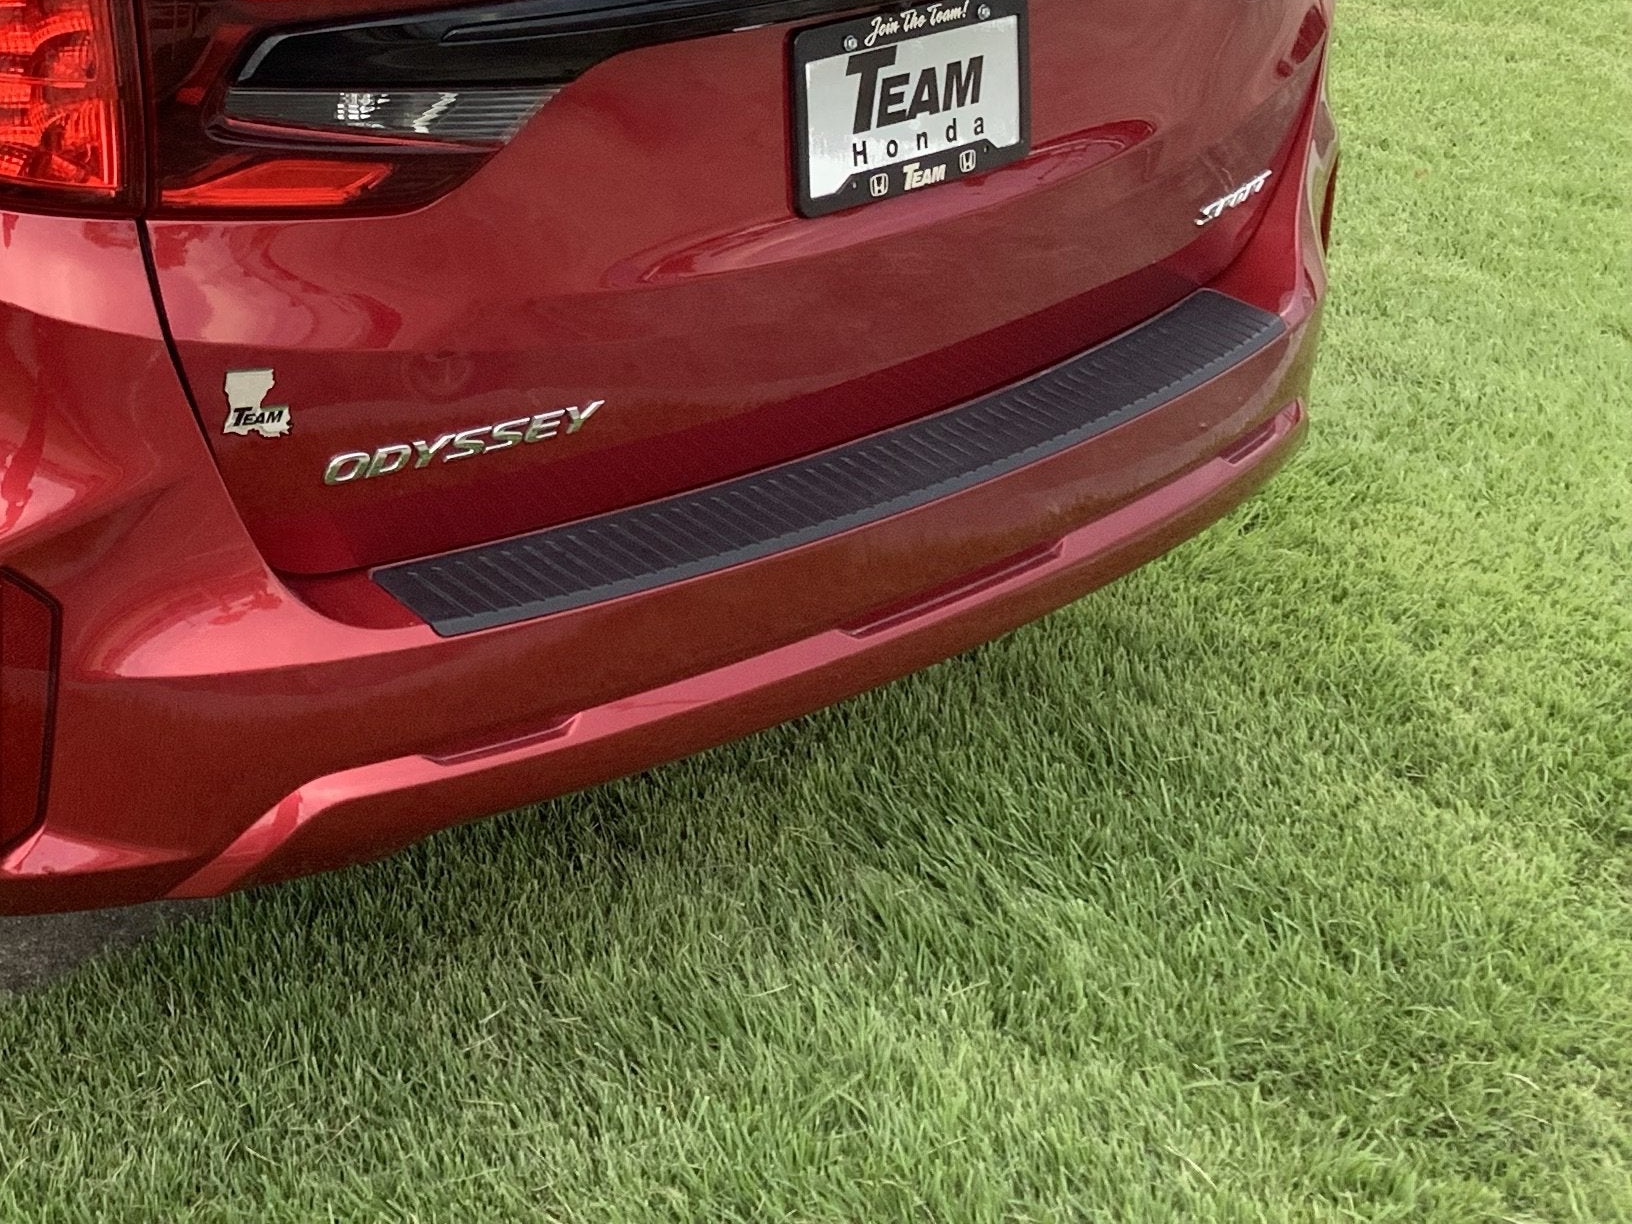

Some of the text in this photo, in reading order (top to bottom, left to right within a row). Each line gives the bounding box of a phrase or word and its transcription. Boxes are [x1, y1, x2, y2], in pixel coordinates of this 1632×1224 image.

[864, 0, 970, 47] Join The Team!
[846, 44, 984, 135] TEAM
[852, 116, 985, 167] Honda
[903, 161, 947, 191] TEAM
[233, 406, 285, 427] TEAM
[322, 399, 606, 486] ODYSSEY
